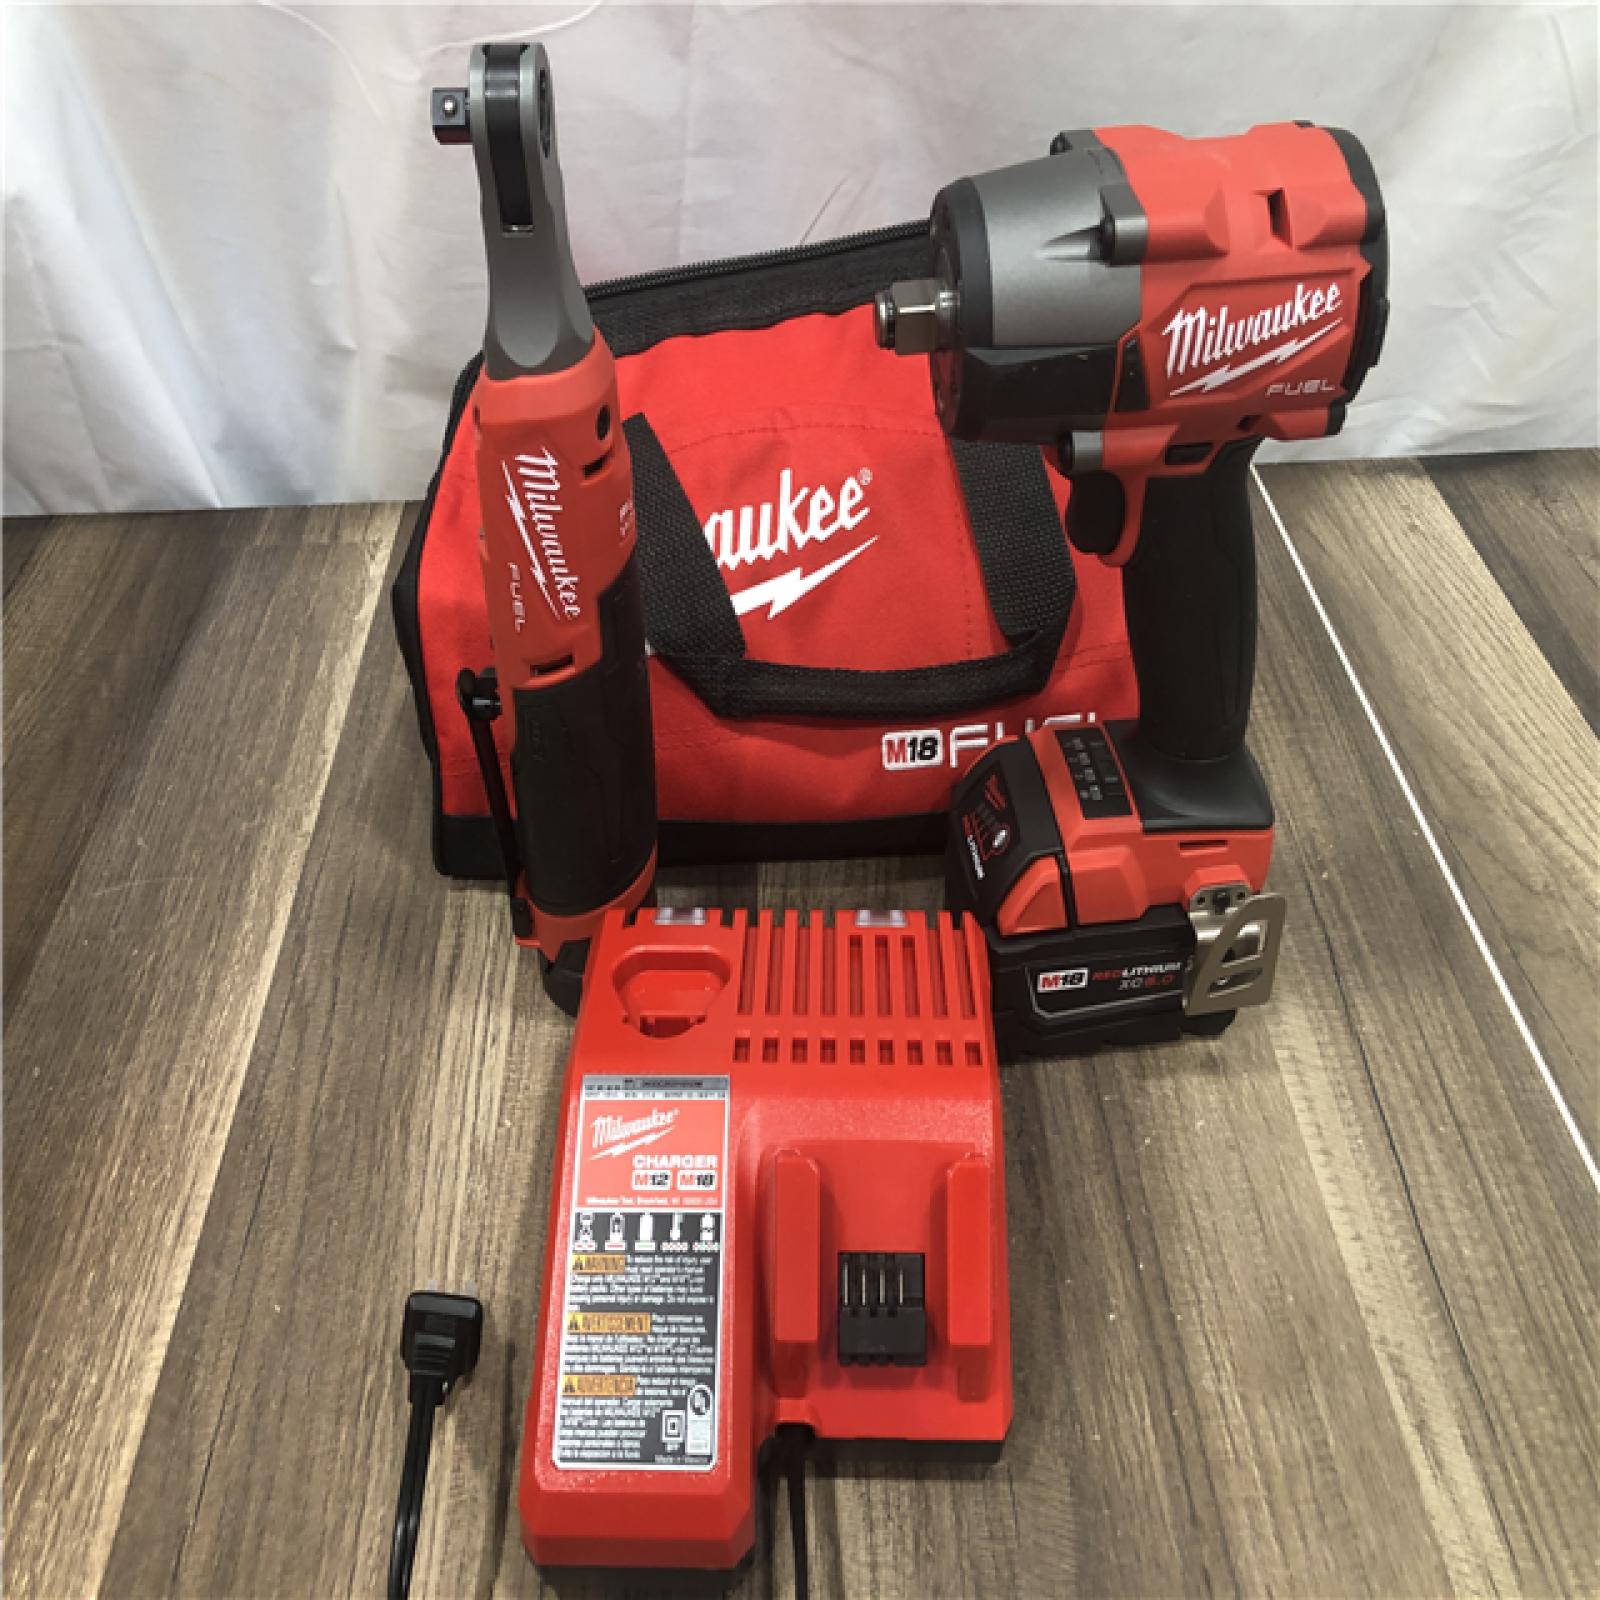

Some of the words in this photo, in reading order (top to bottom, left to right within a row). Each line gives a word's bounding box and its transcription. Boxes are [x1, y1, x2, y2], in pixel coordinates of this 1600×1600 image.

[1162, 282, 1343, 380] Milwaukee
[1265, 378, 1336, 396] FUEL
[514, 446, 581, 621] Milwaukee
[703, 466, 871, 571] aukee
[508, 561, 526, 633] FUEL
[884, 734, 940, 766] M18
[590, 1108, 676, 1149] Milwaukee
[632, 1154, 718, 1169] CHARGER
